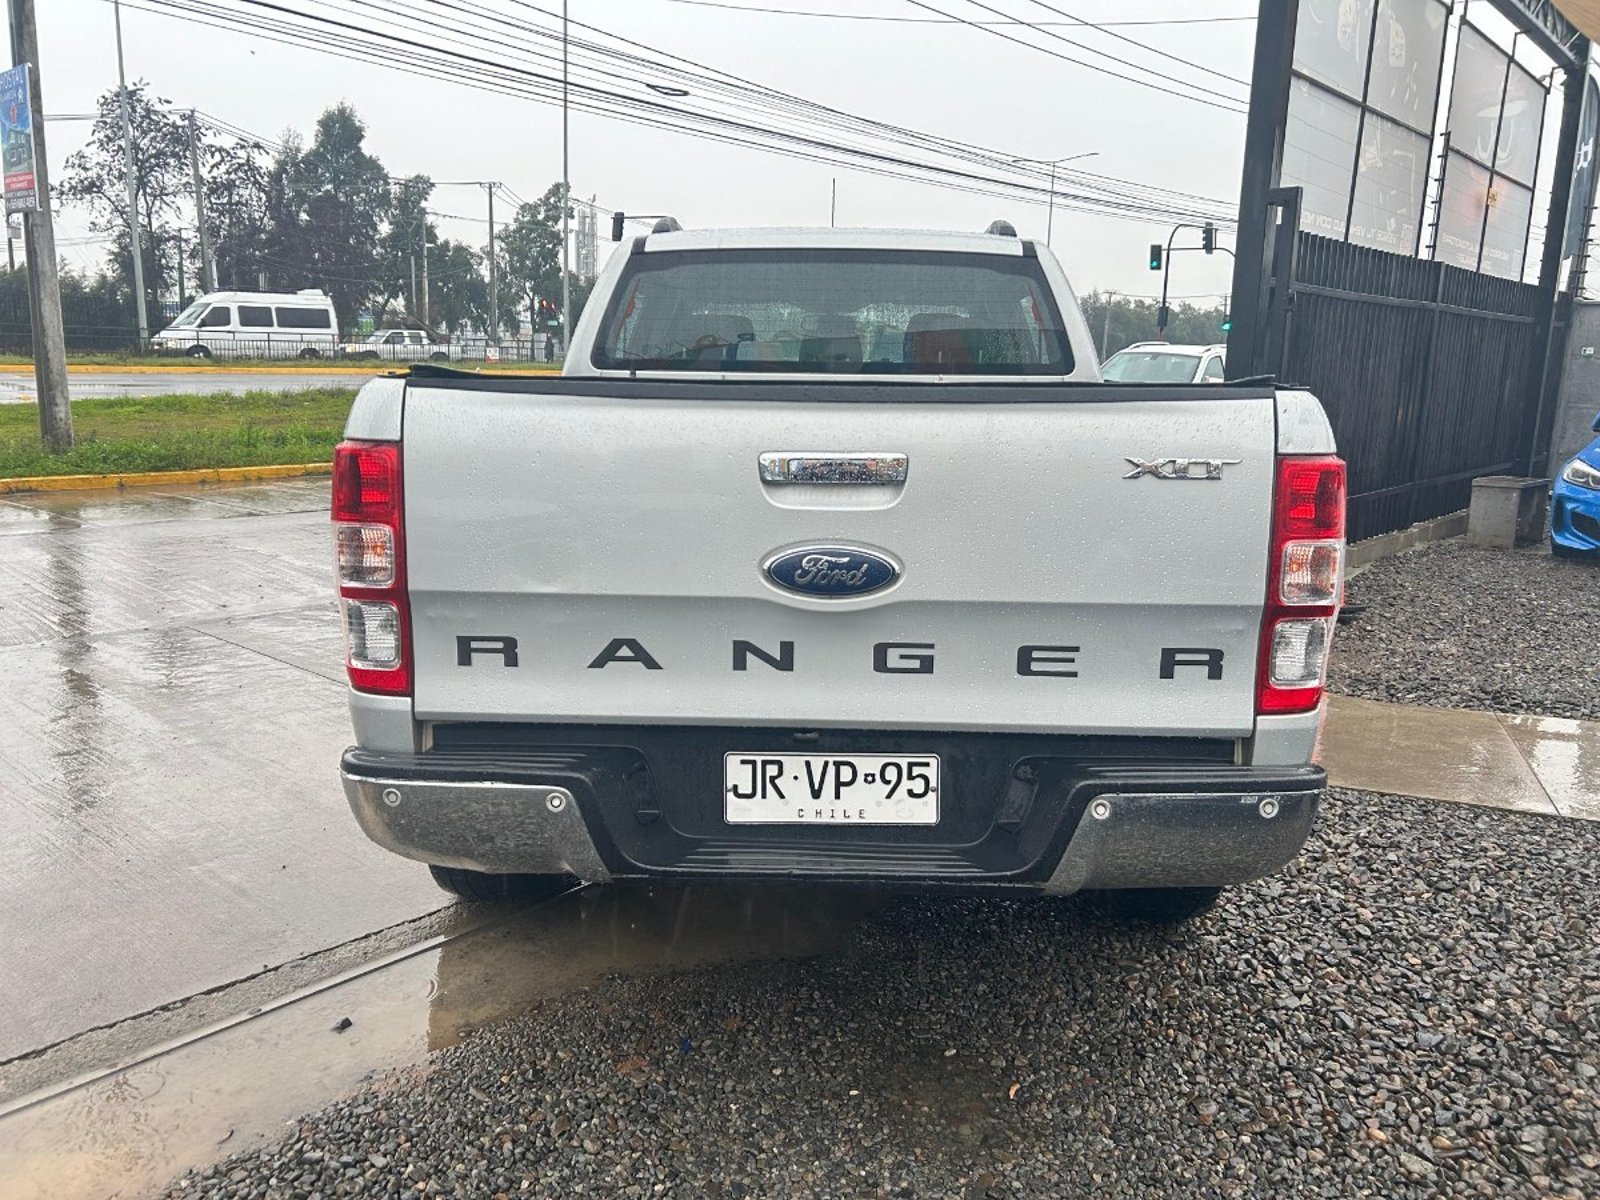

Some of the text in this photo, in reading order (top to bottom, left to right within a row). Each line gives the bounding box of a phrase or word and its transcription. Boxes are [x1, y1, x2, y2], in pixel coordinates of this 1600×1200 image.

[1122, 456, 1244, 480] XLT
[794, 554, 869, 586] Ford
[455, 635, 1224, 680] RANGER
[797, 808, 867, 820] CHILE
